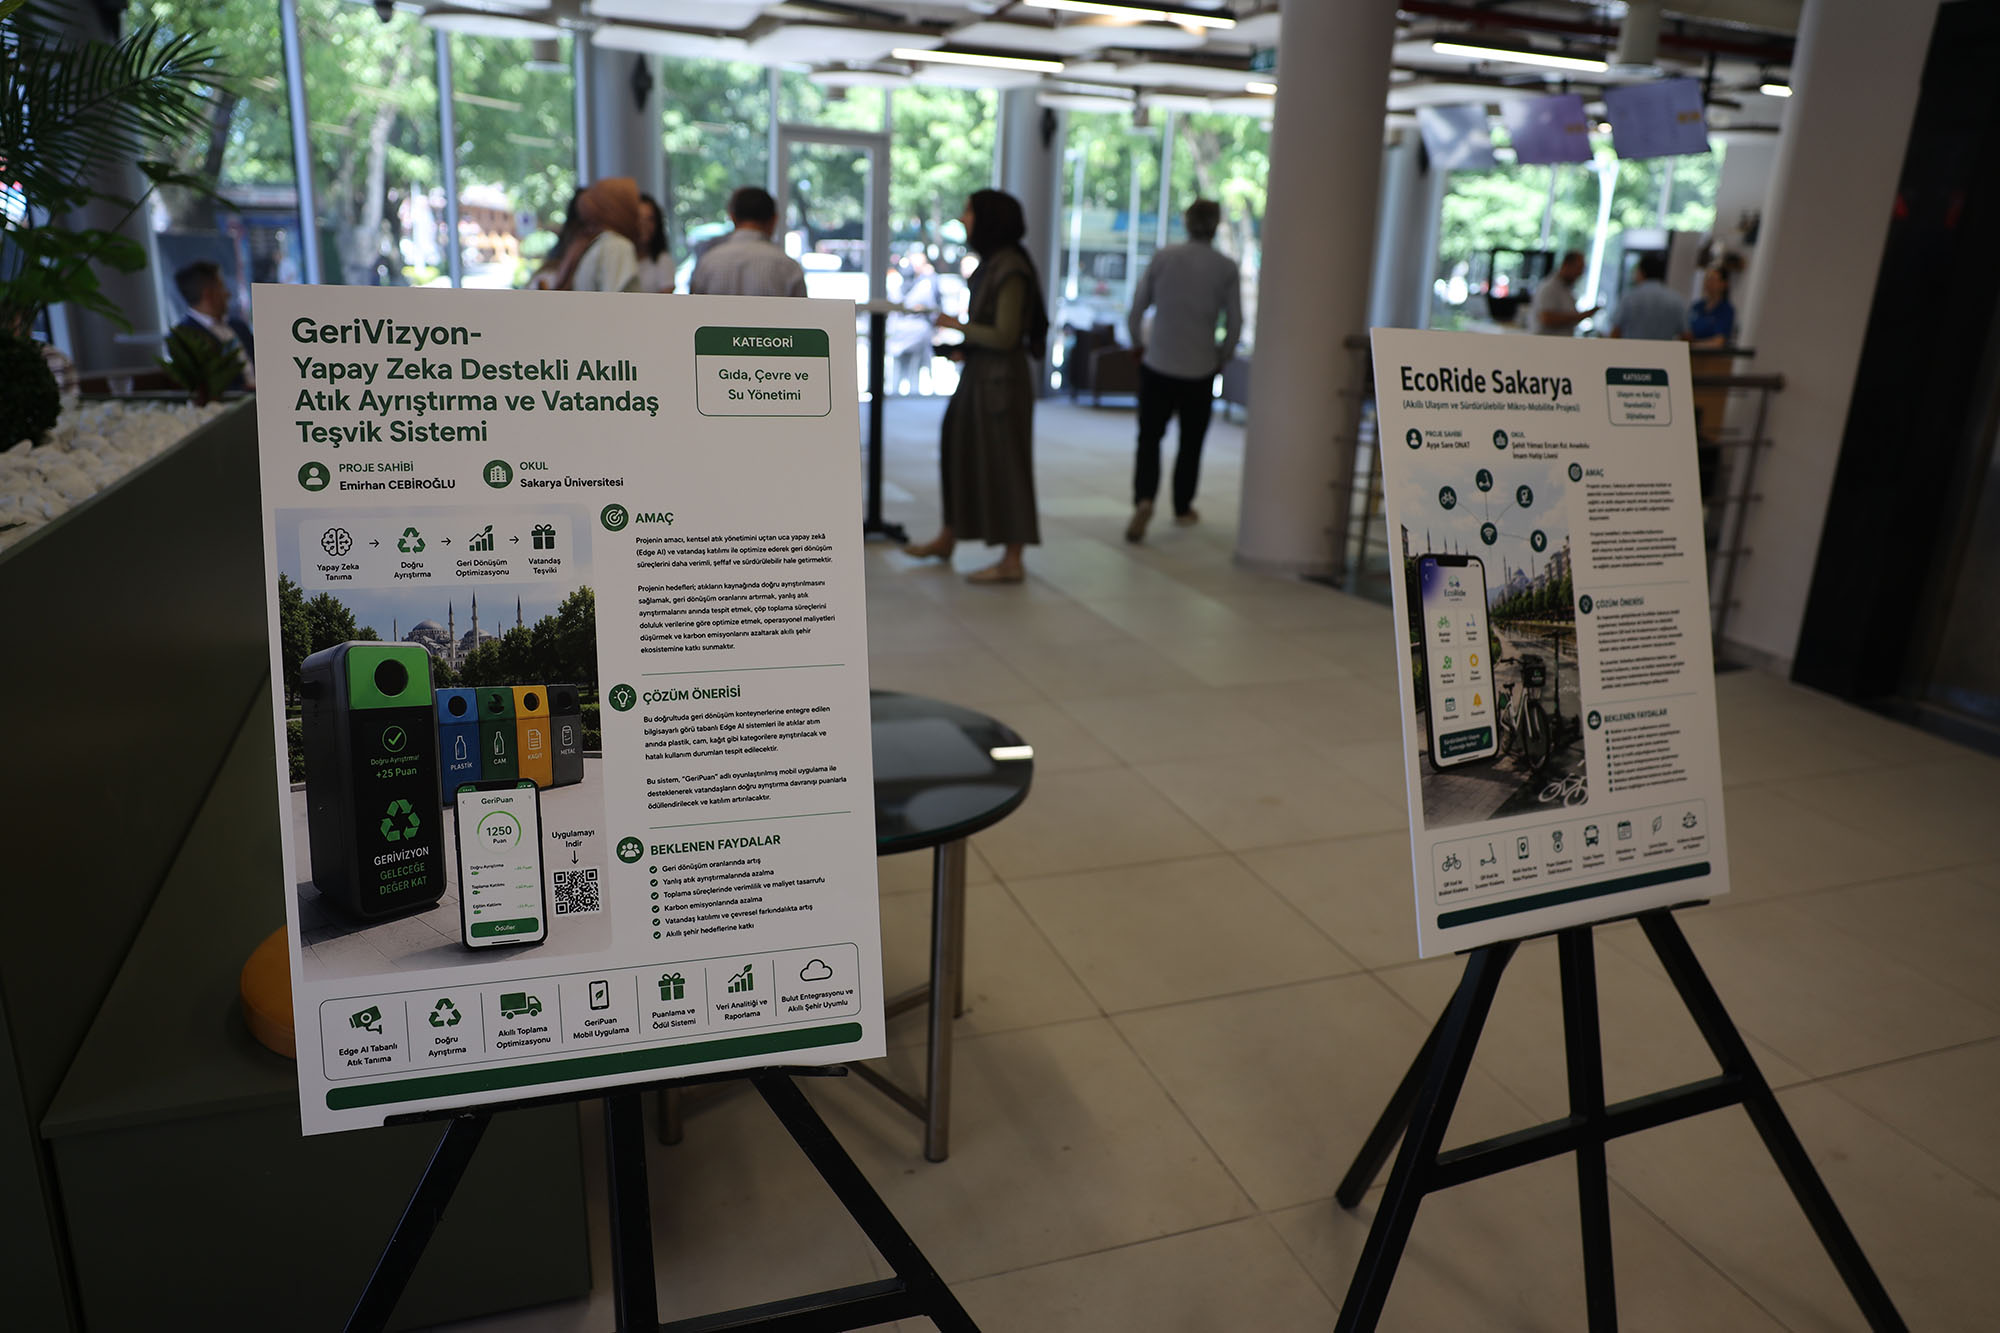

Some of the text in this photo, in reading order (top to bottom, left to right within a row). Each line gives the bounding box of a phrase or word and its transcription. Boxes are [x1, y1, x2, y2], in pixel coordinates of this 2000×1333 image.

[292, 317, 481, 351] GeriVizyon-
[733, 336, 793, 348] KATEGORİ
[293, 357, 637, 385] Yapay Zeka Destekli Akıllı
[719, 369, 809, 383] Gıda, Çevre ve
[1401, 366, 1572, 401] EcoRide Sakarya
[728, 389, 801, 400] Su Yönetimi
[295, 389, 659, 417] Atık Ayrıştırma ve Vatandaş
[295, 420, 487, 448] Teşvik Sistemi
[339, 461, 413, 472] PROJE SAHİBİ
[520, 462, 548, 470] OKUL
[340, 477, 455, 490] Emirhan CEBİROĞLU
[520, 476, 623, 489] Sakarya Üniversitesi
[635, 512, 674, 525] AMAÇ
[636, 537, 663, 545] Projenin
[724, 535, 757, 543] yönetimini
[317, 564, 340, 572] Yapay
[401, 561, 423, 570] Doğru
[473, 559, 508, 567] Dönüşüm
[394, 572, 431, 580] Ayrıştırma
[455, 569, 509, 578] Optimizasyonu
[533, 567, 557, 575] Teşviki
[643, 685, 741, 705] ÇÖZÜM ÖNERİSİ
[450, 761, 473, 770] PLASTİK
[376, 768, 417, 778] +25 Puan
[481, 797, 513, 805] GeriPuan
[486, 826, 512, 836] 1250
[552, 830, 595, 839] Uygulamayı
[651, 835, 781, 855] BEKLENEN FAYDALAR
[374, 846, 429, 866] GERİVİZYON
[677, 863, 708, 871] dönüşüm
[709, 859, 745, 868] oranlarında
[380, 862, 425, 880] GELECEĞE
[697, 872, 750, 883] ayrıştırmalarında
[752, 869, 774, 877] azalma
[380, 876, 427, 895] DEĞER KAT
[663, 891, 691, 899] Toplama
[693, 886, 732, 895] süreçlerinde
[733, 883, 762, 891] verimlilik
[772, 880, 795, 888] maliyet
[796, 877, 825, 885] tasarrufu
[689, 898, 738, 909] emisyonlarında
[665, 916, 696, 924] Vatandaş
[730, 909, 758, 919] çevresel
[759, 906, 798, 915] farkındalıkta
[683, 928, 699, 937] şehir
[700, 925, 737, 934] hedeflerine
[781, 995, 799, 1003] Bulut
[800, 991, 844, 1000] Entegrasyonu
[731, 1000, 758, 1009] Analitiği
[805, 1002, 822, 1011] Şehir
[823, 1000, 848, 1009] Uyumlu
[652, 1010, 686, 1018] Puanlama
[724, 1011, 761, 1021] Raporlama
[584, 1018, 617, 1027] GeriPuan
[652, 1018, 696, 1029] Ödül Sistemi
[498, 1026, 548, 1037] Akıllı Toplama
[573, 1028, 629, 1039] Mobil Uygulama
[435, 1036, 458, 1045] Doğru
[496, 1037, 551, 1049] Optimizasyonu
[339, 1048, 359, 1056] Edge
[370, 1043, 397, 1052] Tabanlı
[428, 1047, 466, 1058] Ayrıştırma
[347, 1056, 392, 1066] Atık Tanıma
